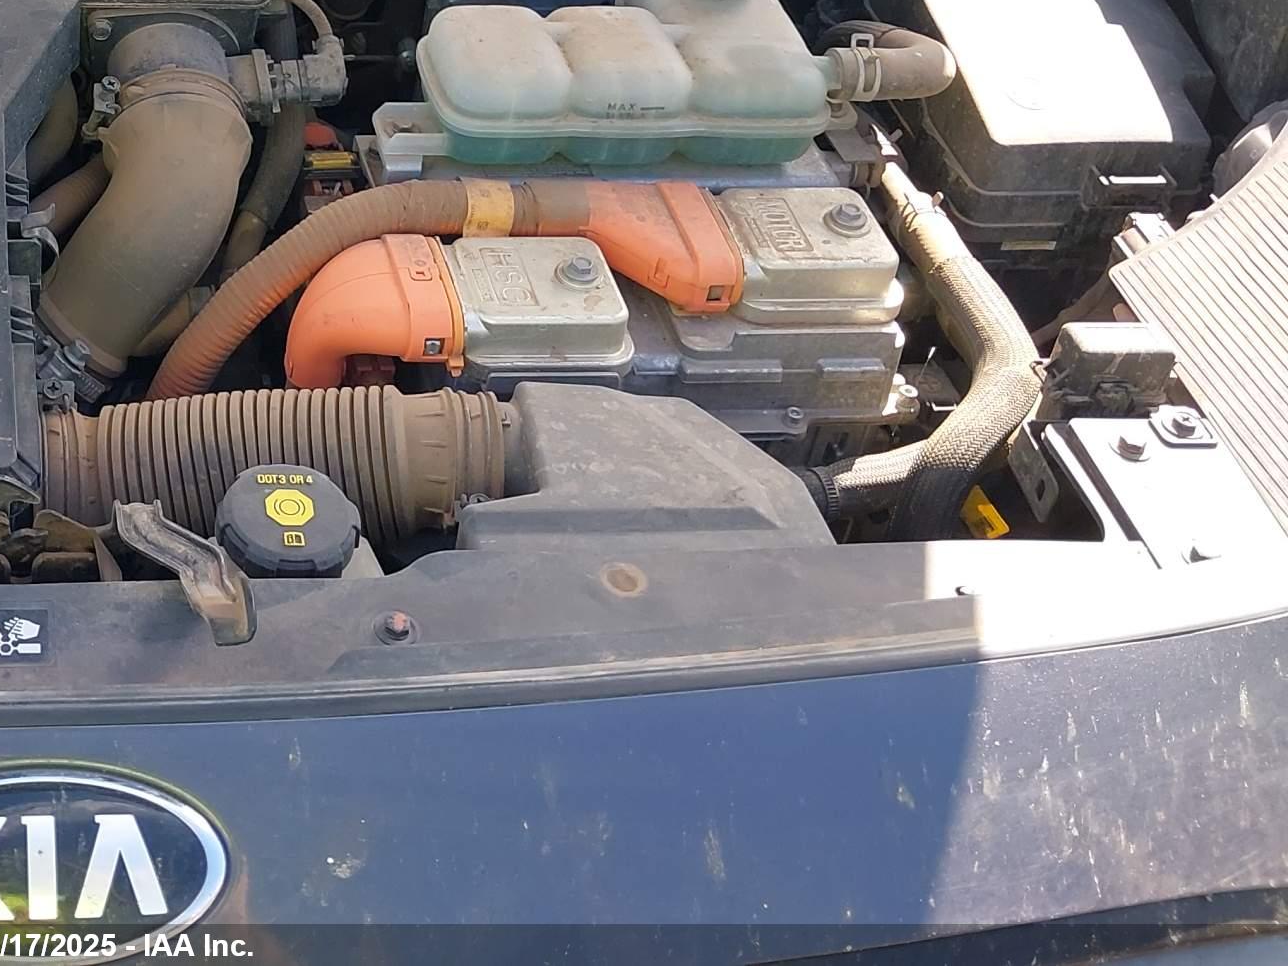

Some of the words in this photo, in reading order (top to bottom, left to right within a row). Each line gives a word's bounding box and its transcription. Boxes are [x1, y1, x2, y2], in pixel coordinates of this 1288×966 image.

[607, 102, 637, 111] MAX
[755, 201, 808, 249] MOTOR
[289, 475, 304, 484] OR
[306, 475, 313, 483] 4
